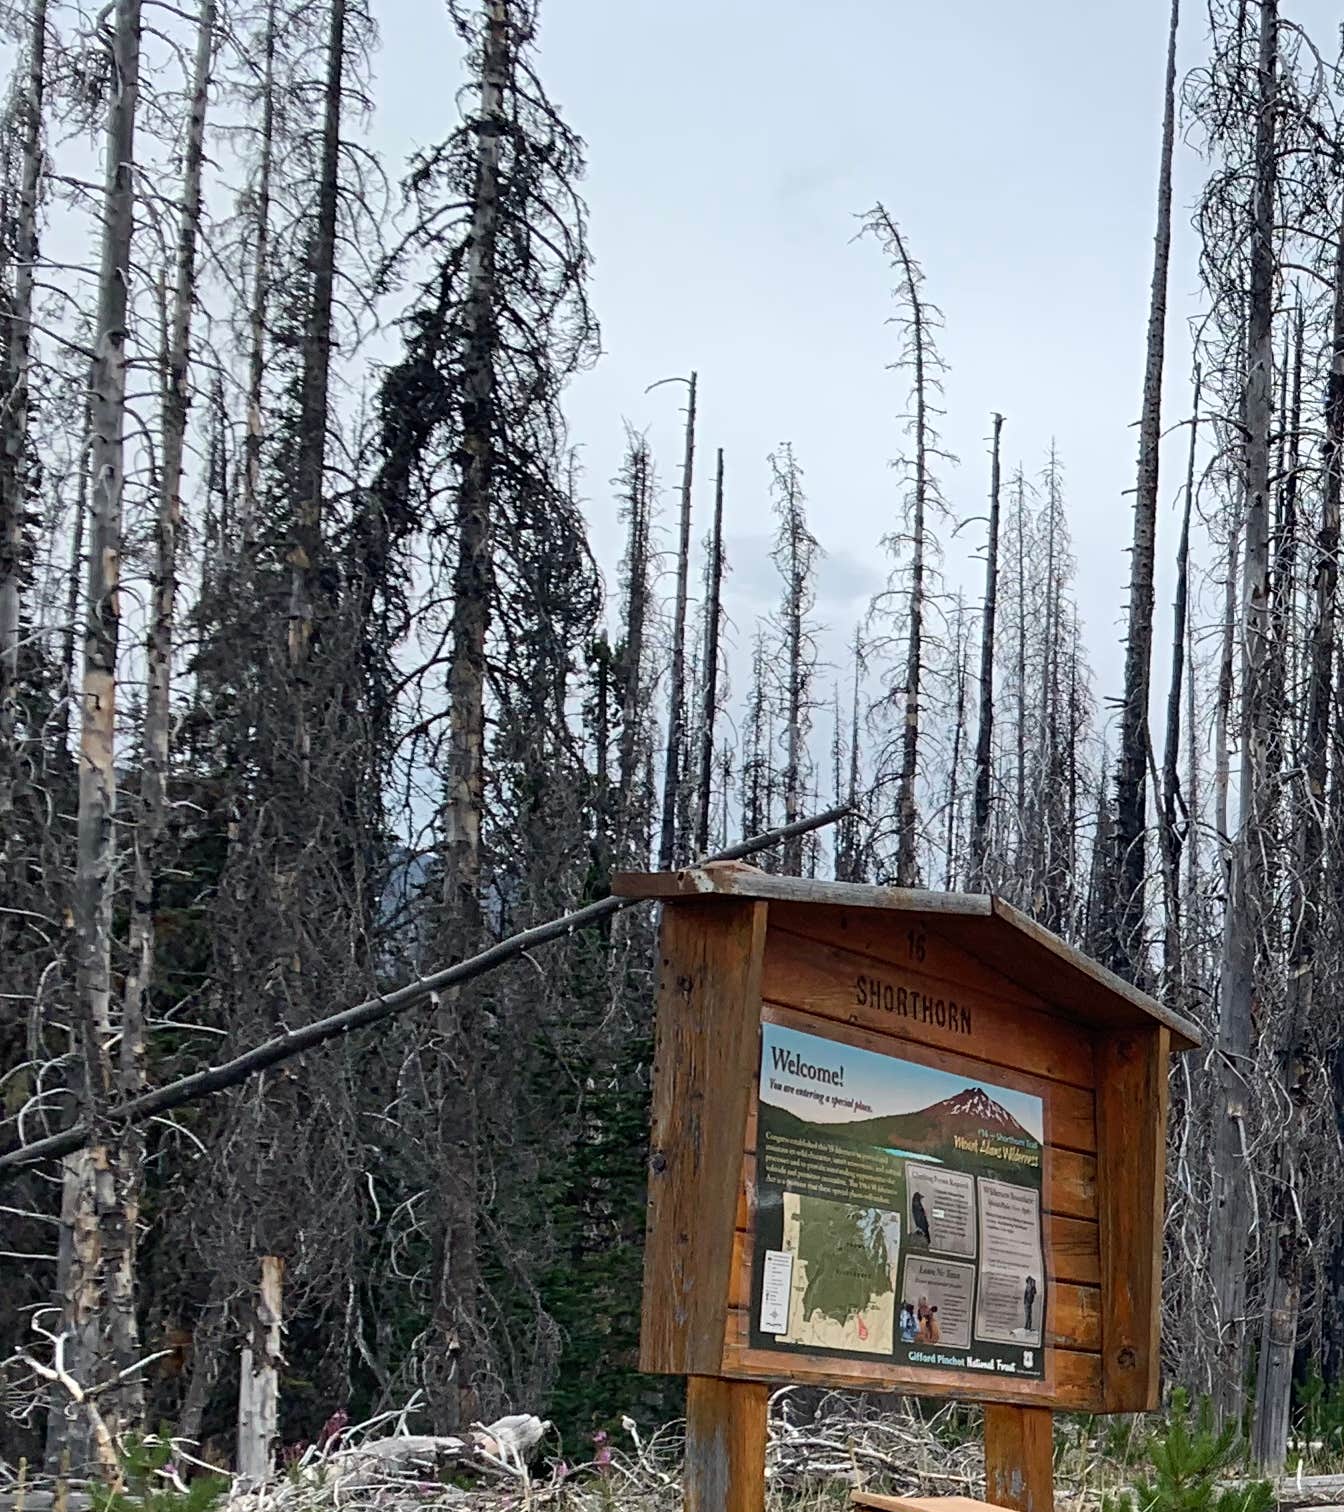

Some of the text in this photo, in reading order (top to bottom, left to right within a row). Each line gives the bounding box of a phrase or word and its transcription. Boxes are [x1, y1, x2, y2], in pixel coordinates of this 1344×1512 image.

[907, 928, 928, 963] 16
[856, 975, 972, 1035] SHORTHORN
[770, 1046, 845, 1087] Welcome!
[769, 1078, 783, 1092] You
[783, 1085, 795, 1095] are
[795, 1087, 825, 1105] entering
[831, 1096, 854, 1108] special
[854, 1100, 873, 1113] place.
[1003, 1146, 1039, 1167] Wilderness
[908, 1351, 936, 1363] Gifford
[937, 1354, 965, 1366] Pinchot
[966, 1356, 995, 1370] National
[996, 1359, 1016, 1373] Forest
